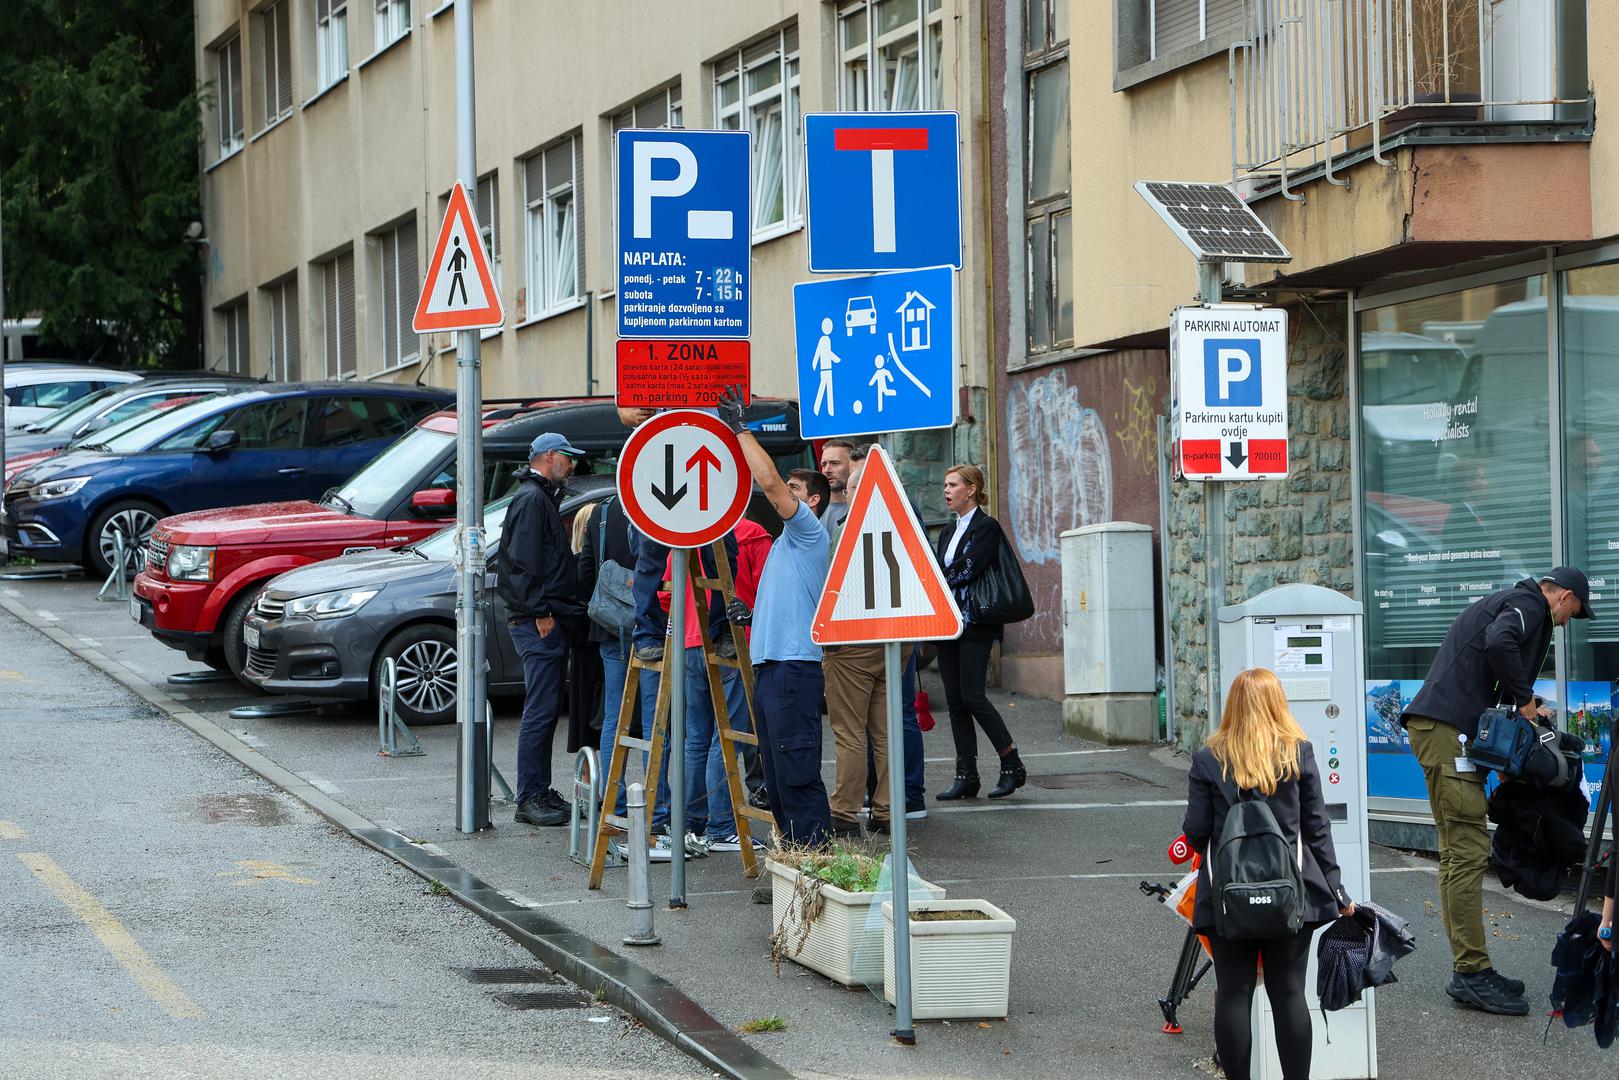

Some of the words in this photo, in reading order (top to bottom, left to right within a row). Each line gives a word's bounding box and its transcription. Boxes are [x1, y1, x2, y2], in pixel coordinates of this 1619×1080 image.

[633, 141, 698, 238] P
[624, 252, 686, 266] NAPLATA:
[624, 274, 654, 285] ponedj.
[662, 274, 686, 285] petak
[696, 270, 702, 283] 7
[716, 269, 732, 283] 22
[736, 272, 742, 284] h
[624, 290, 652, 299] subota
[696, 287, 702, 300] 7
[717, 286, 732, 300] 15
[736, 287, 742, 300] h
[624, 303, 666, 314] parkiranje
[668, 304, 712, 314] dozvoljeno
[624, 316, 666, 327] kupljenom
[669, 317, 711, 328] parkirnom
[714, 318, 742, 327] kartom
[1184, 320, 1230, 332] PARKIRNI
[1232, 320, 1280, 332] AUTOMAT
[649, 344, 658, 360] 1.
[667, 344, 718, 360] ZONA
[1218, 349, 1252, 400] P
[633, 392, 688, 404] m-parking
[1424, 402, 1452, 421] Holiday
[1454, 396, 1478, 416] rental
[1186, 412, 1226, 423] Parkirnu
[1229, 412, 1254, 423] kartu
[1256, 412, 1283, 426] kupiti
[1221, 426, 1248, 439] ovdje
[1432, 422, 1469, 447] specialists
[1183, 452, 1221, 461] m-parking
[1254, 452, 1281, 460] 700101
[1429, 552, 1440, 560] home
[1442, 551, 1450, 560] and
[1451, 550, 1470, 561] generate
[1470, 550, 1482, 558] extra
